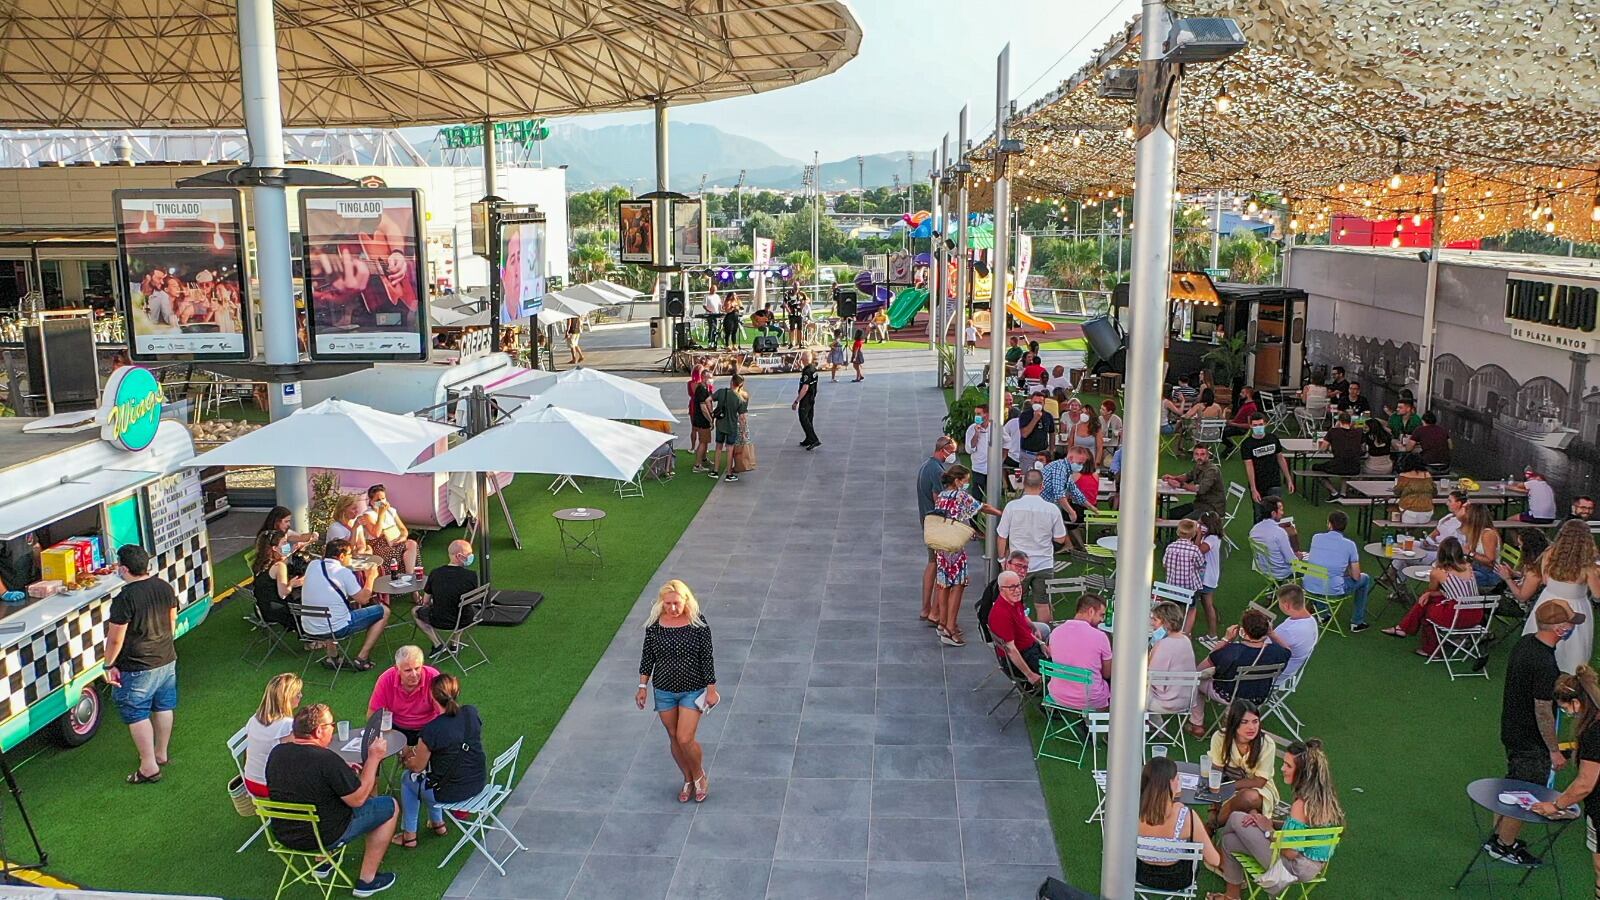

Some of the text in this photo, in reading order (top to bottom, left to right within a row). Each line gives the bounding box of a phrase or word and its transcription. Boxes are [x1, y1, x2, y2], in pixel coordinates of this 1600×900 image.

[156, 203, 200, 214] TINGLADO
[339, 202, 381, 213] TINGLADO
[1504, 279, 1597, 332] TINGLADO
[1513, 328, 1587, 349] DE PLAZA MAYOR
[107, 381, 164, 440] Wings
